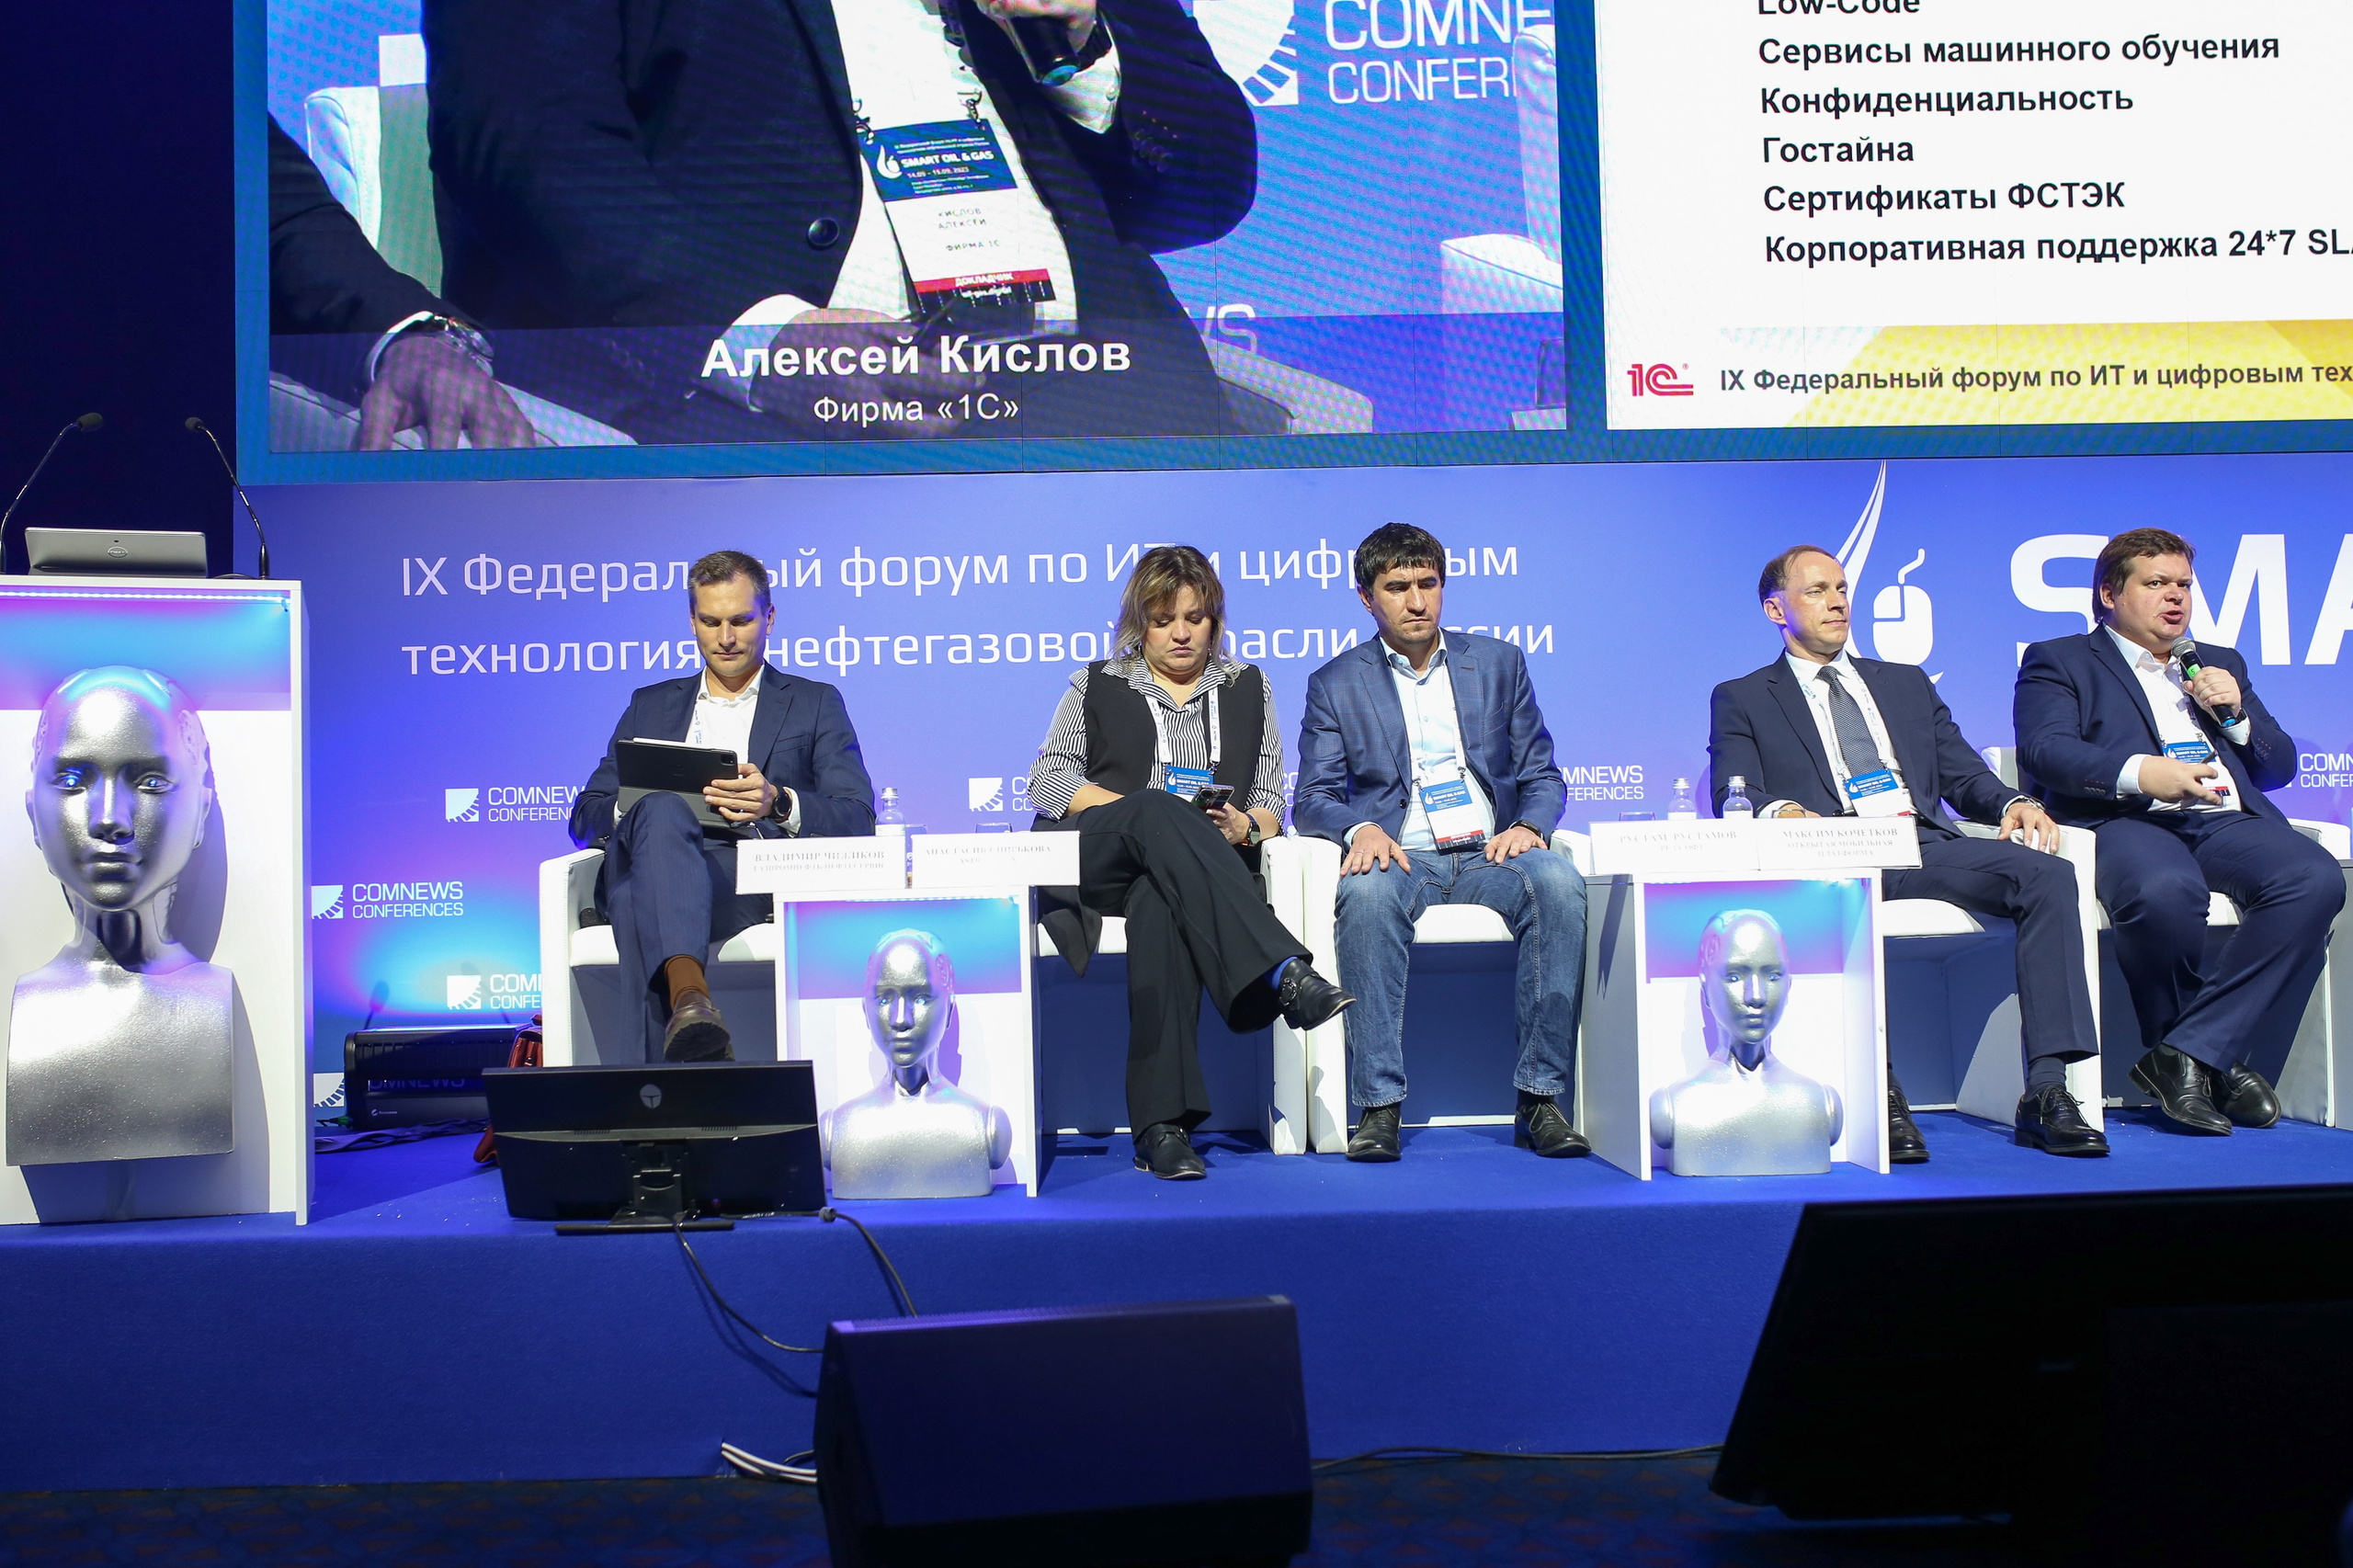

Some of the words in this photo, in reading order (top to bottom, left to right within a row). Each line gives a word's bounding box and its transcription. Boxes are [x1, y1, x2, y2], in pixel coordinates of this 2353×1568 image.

[1758, 38, 1911, 71] Сервисы
[1924, 40, 2110, 62] машинного
[2121, 33, 2279, 67] обучения
[1327, 57, 1518, 104] CONFER
[1761, 87, 2133, 119] Конфиденциальность
[901, 155, 939, 168] SMART
[941, 153, 961, 164] OIL
[971, 151, 995, 161] GAS
[1763, 136, 1915, 163] Гостайна
[1764, 185, 1996, 218] Сертификаты
[2008, 182, 2125, 209] ФСТЭК
[1766, 236, 2025, 268] Корпоративная
[2038, 236, 2218, 265] поддержка
[2308, 229, 2353, 256] SL
[700, 336, 918, 378] Алексей
[940, 335, 1131, 374] Кислов
[1722, 369, 1745, 391] IX
[1754, 368, 1944, 394] Федеральный
[1951, 367, 2041, 392] форум
[2051, 369, 2081, 387] по
[2090, 365, 2125, 385] ИТ
[2133, 369, 2147, 385] и
[2157, 364, 2303, 389] цифровым
[813, 395, 924, 428] Фирма
[403, 557, 449, 596] IX
[464, 548, 822, 603] Федералый
[840, 546, 1009, 597] форум
[1029, 552, 1088, 584] по
[1558, 765, 1643, 784] MNEWS
[353, 881, 463, 902] COMNEWS
[353, 903, 463, 919] CONFERENCES
